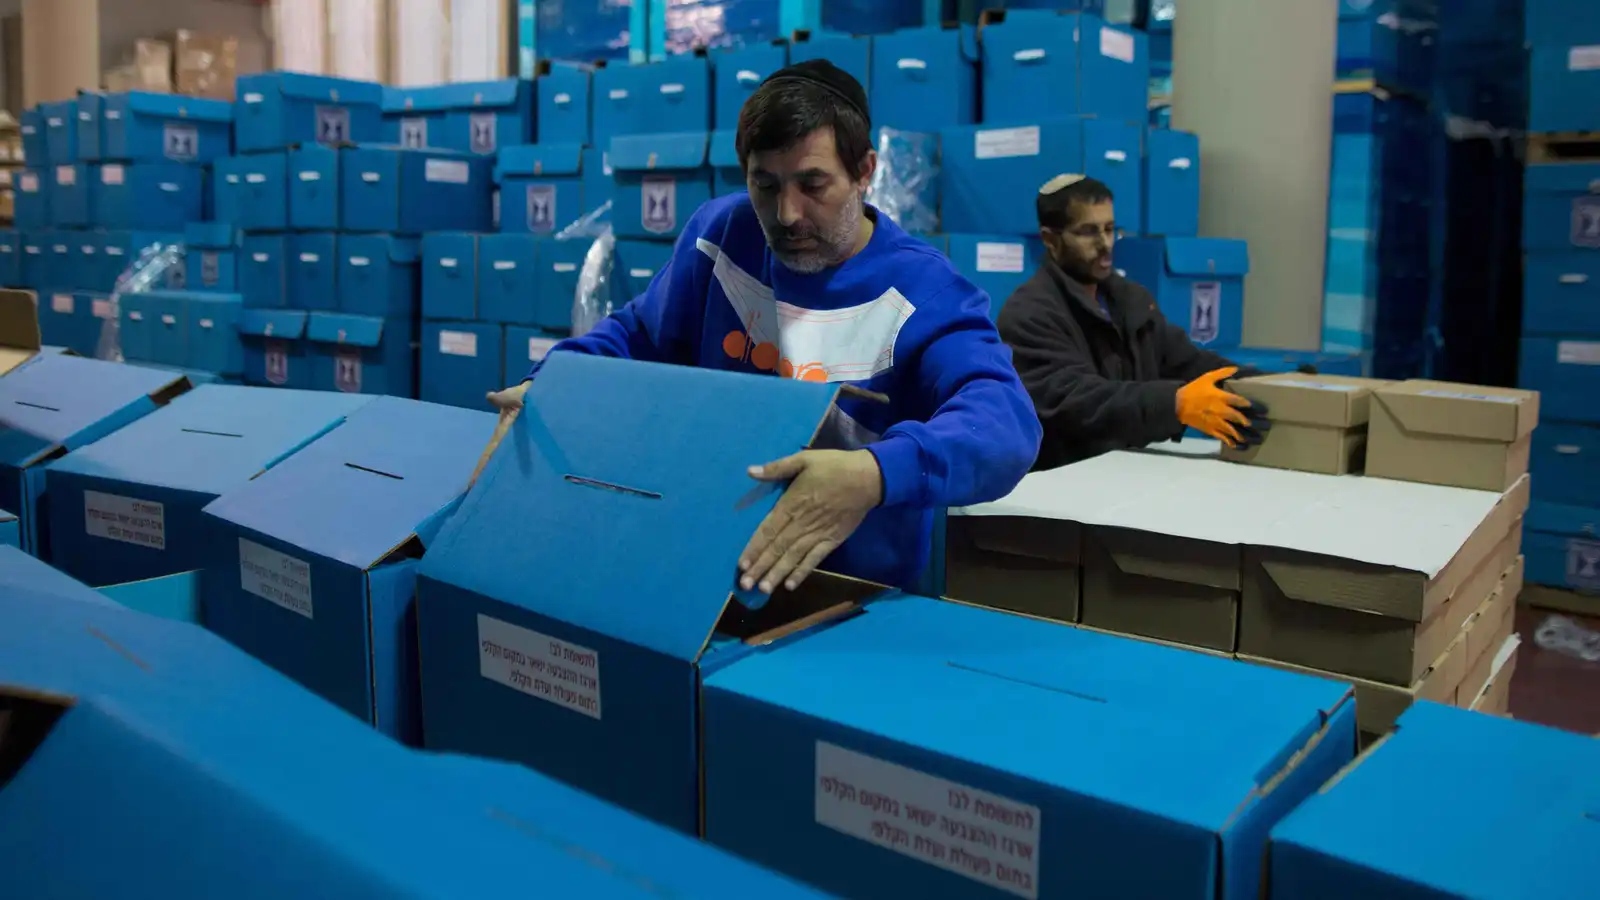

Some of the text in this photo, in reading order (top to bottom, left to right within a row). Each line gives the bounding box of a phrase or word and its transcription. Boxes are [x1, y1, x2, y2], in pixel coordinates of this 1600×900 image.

[820, 775, 856, 802] הקלפי
[860, 789, 900, 818] במקום
[975, 799, 1034, 831] לתשומת
